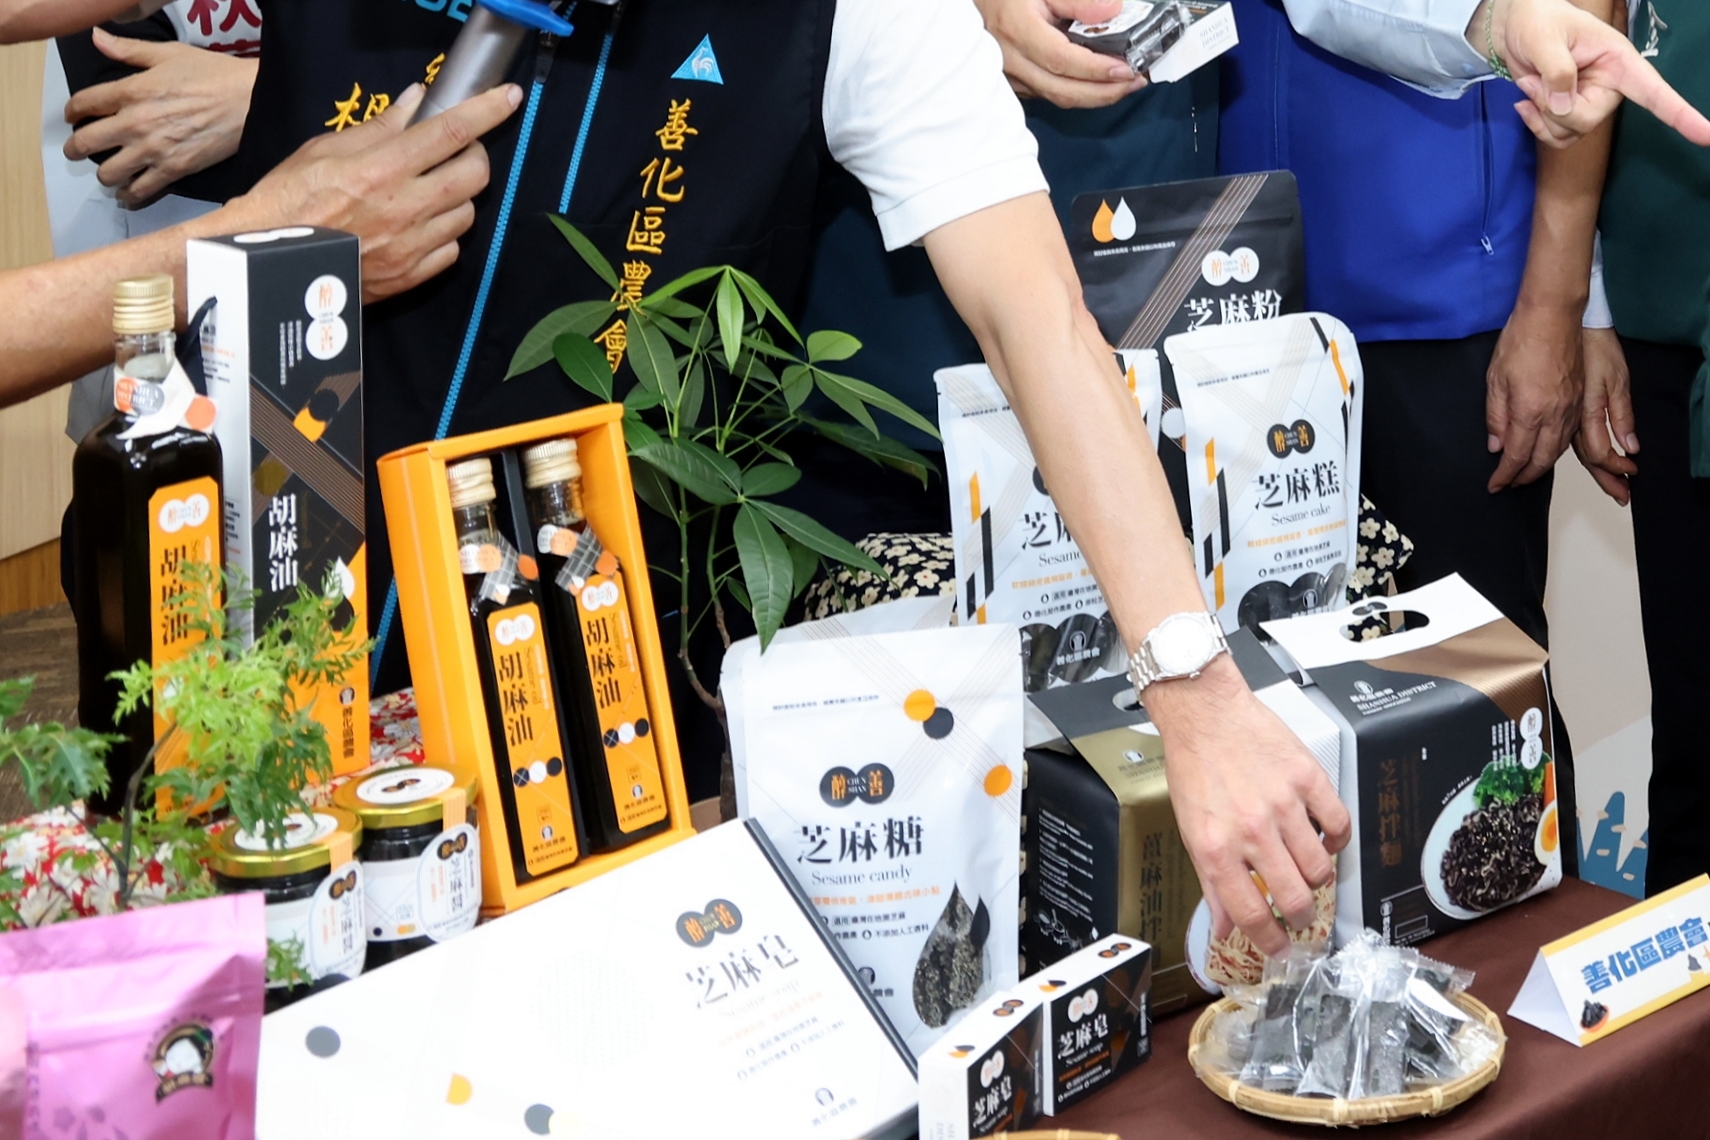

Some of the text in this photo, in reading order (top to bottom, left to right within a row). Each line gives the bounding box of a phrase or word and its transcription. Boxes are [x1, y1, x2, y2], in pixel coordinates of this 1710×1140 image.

[594, 99, 698, 374] 善化區農會
[1183, 289, 1282, 333] 芝麻粉
[1251, 460, 1341, 511] 芝麻糕
[1271, 502, 1331, 527] Sesame cake
[268, 493, 299, 592] 胡麻油
[161, 544, 188, 646] 胡麻油
[586, 617, 622, 709] 胡麻油
[498, 651, 534, 747] 胡麻油
[847, 777, 867, 786] CHUN
[848, 785, 867, 793] SHAN
[793, 816, 924, 864] 芝麻糖
[811, 864, 912, 886] Sesame candy
[685, 934, 799, 1010] 芝麻皂
[1581, 916, 1709, 994] 善化區農會
[1057, 1013, 1108, 1060] 芝麻皂
[972, 1075, 1012, 1128] 芝麻皂
